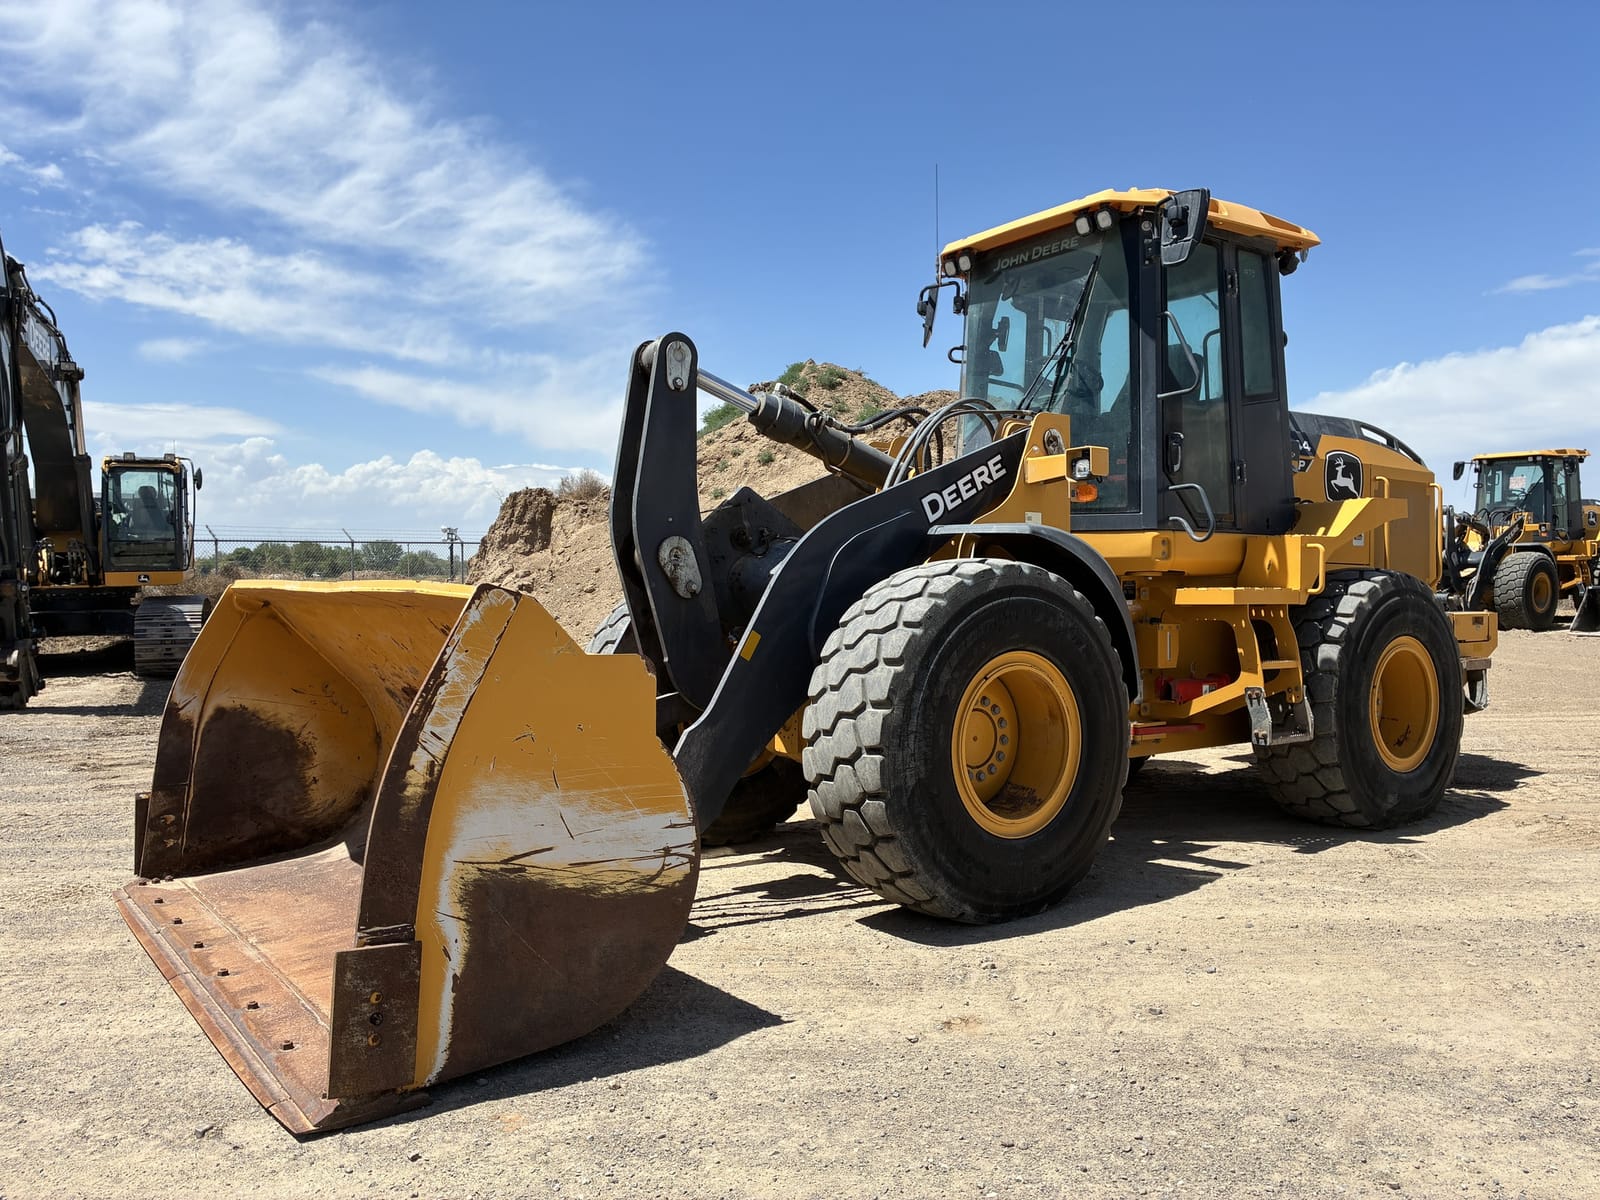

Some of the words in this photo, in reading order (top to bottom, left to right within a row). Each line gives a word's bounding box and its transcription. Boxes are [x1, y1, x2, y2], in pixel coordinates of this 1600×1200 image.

[993, 251, 1030, 272] JOHN
[1031, 236, 1080, 260] DEERE
[921, 454, 1008, 524] DEERE
